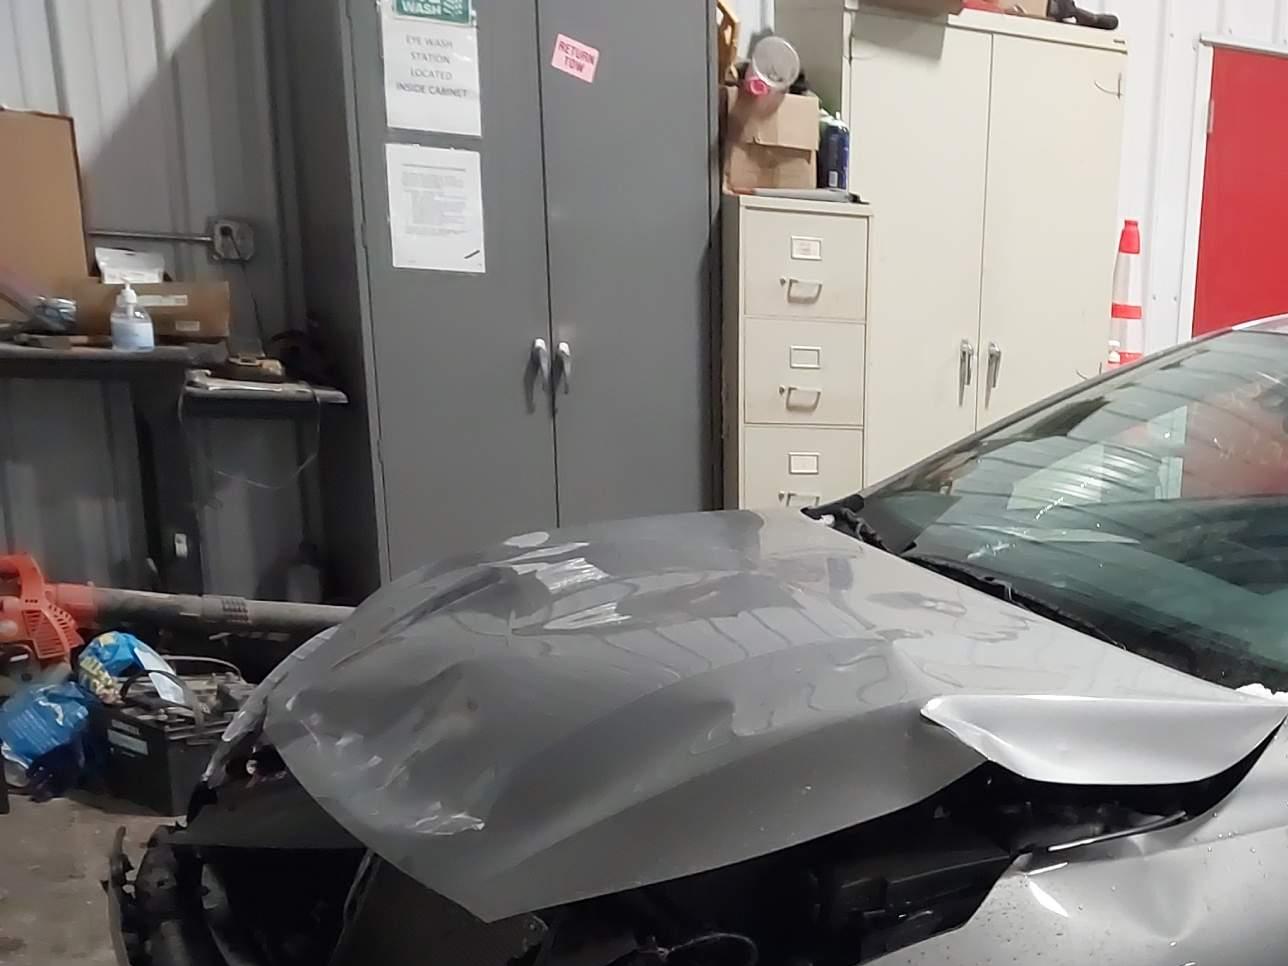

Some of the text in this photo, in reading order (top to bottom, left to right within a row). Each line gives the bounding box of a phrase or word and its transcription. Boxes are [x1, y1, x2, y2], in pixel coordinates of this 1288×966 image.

[400, 0, 441, 15] WASH
[425, 36, 453, 48] WASH
[410, 52, 450, 64] STATION
[559, 41, 594, 65] RETURN
[411, 67, 453, 81] LOCATED
[396, 82, 469, 98] INSIDE CABINET
